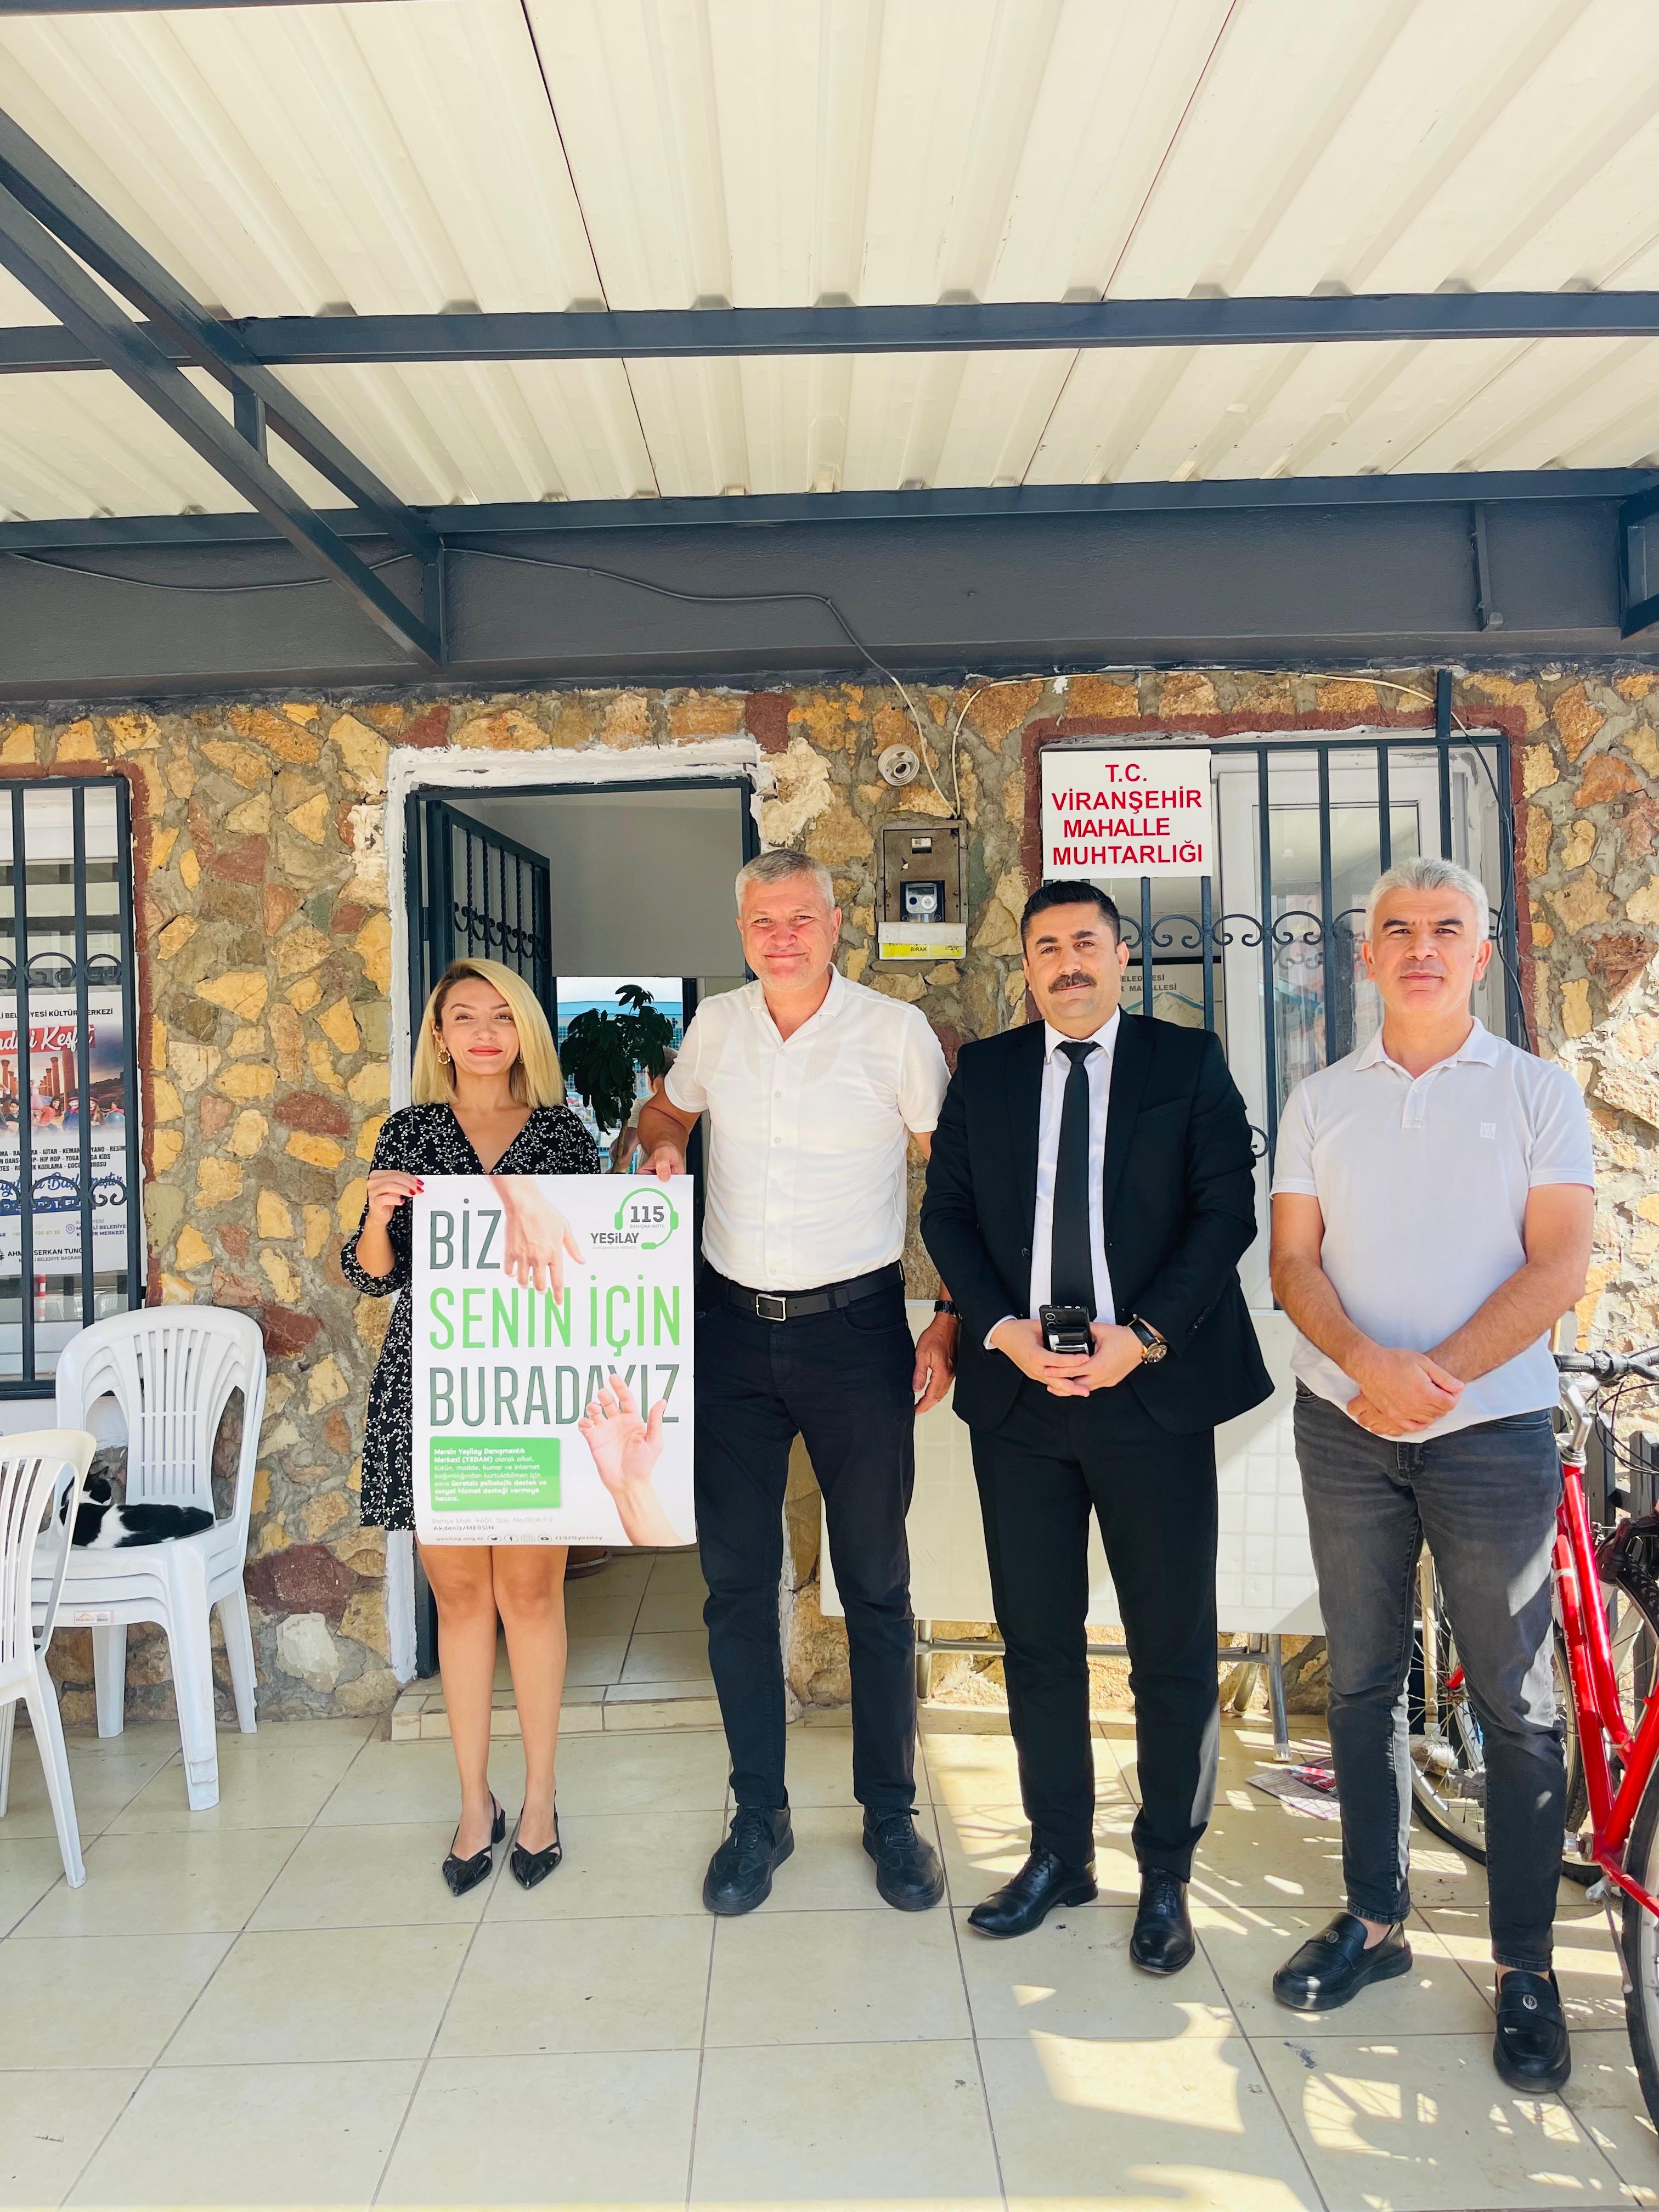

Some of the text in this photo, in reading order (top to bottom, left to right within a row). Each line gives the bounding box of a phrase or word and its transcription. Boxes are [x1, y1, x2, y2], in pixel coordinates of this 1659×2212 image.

[1105, 764, 1147, 782] T.C.
[1052, 786, 1202, 814] VİRANŞEHİR
[1064, 817, 1170, 837] MAHALLE
[1053, 839, 1202, 865] MUHTARLIĞI
[630, 1206, 664, 1222] 115
[430, 1198, 501, 1269] BİZ
[430, 1274, 680, 1357] SENİN İÇİN
[430, 1364, 680, 1426] BURADAYIZ
[462, 1455, 493, 1464] (YEDAM)
